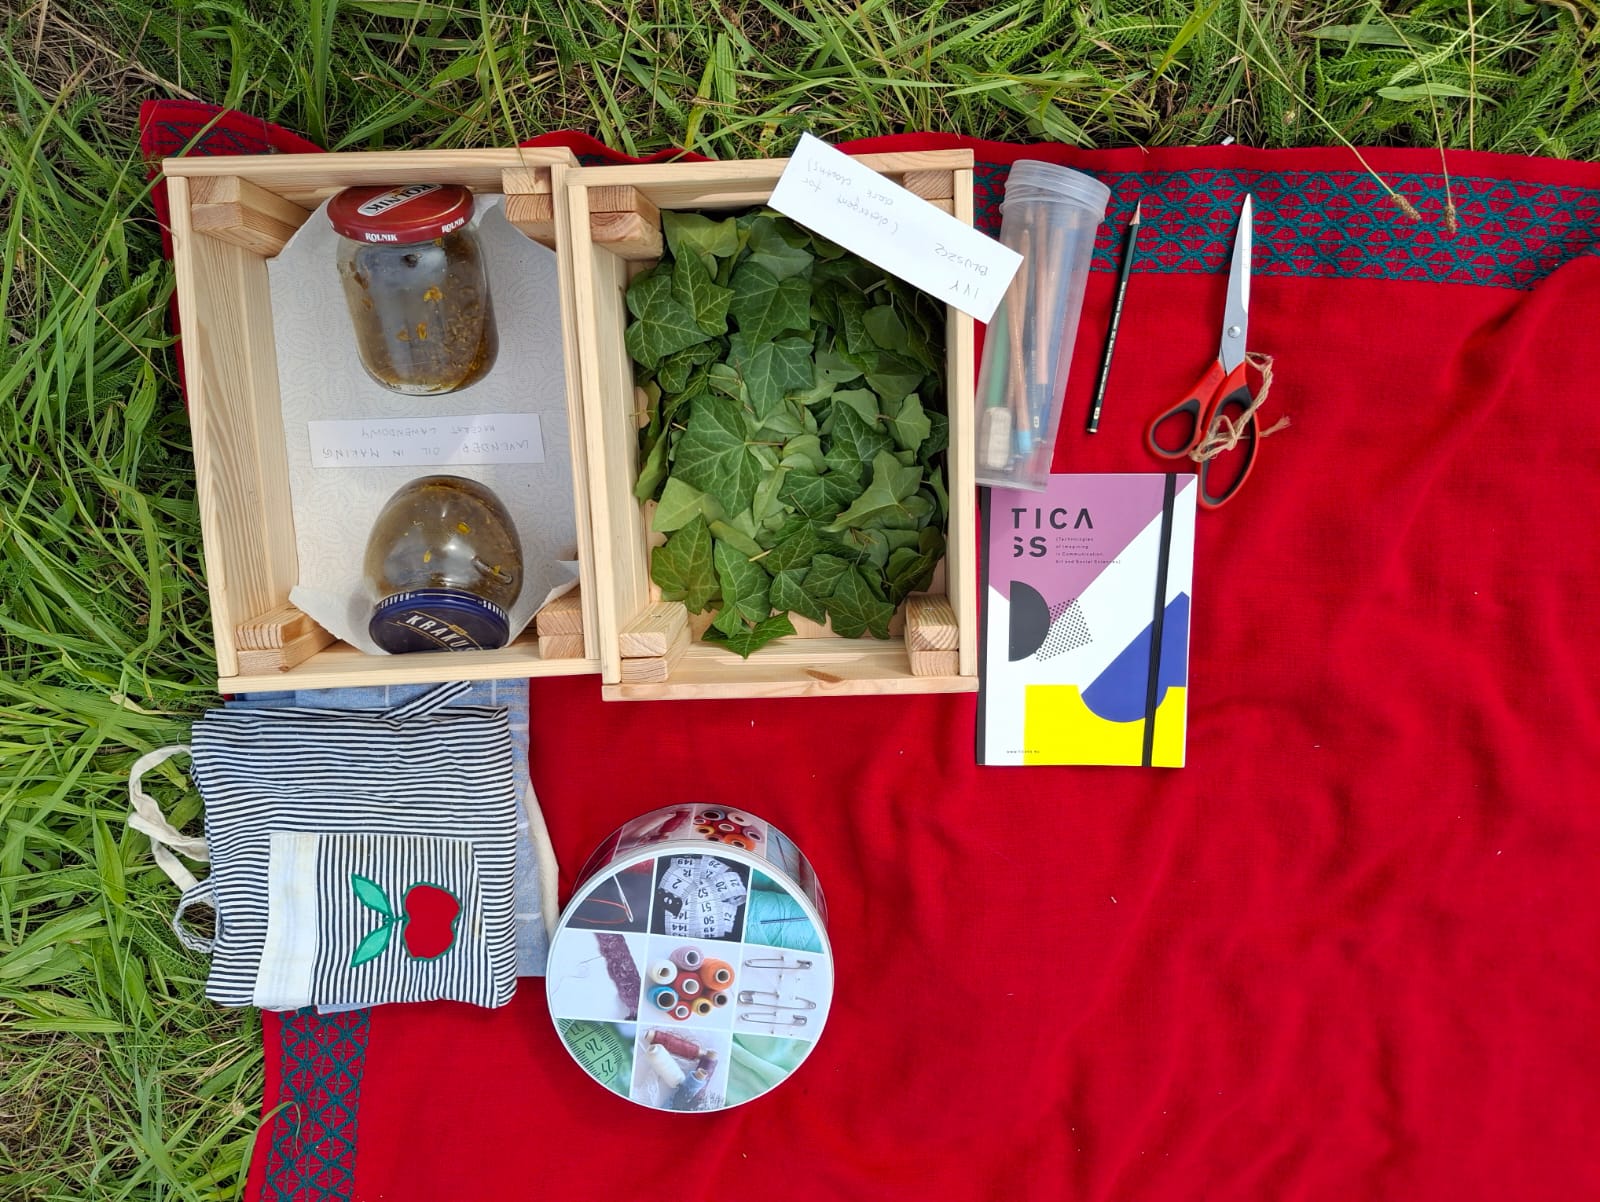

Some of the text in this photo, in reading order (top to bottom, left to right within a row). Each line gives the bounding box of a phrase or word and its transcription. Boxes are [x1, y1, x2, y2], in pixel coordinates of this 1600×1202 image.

[442, 217, 465, 233] ROLNIK
[365, 232, 398, 242] ROLNIK
[950, 280, 979, 299] IVY
[322, 440, 529, 460] LAVENDER OIL IN MAKING
[1011, 508, 1094, 529] TICA
[715, 881, 727, 893] 20
[701, 903, 712, 912] 51
[704, 916, 715, 925] 50
[585, 1038, 602, 1055] 26
[602, 1059, 613, 1076] 25
